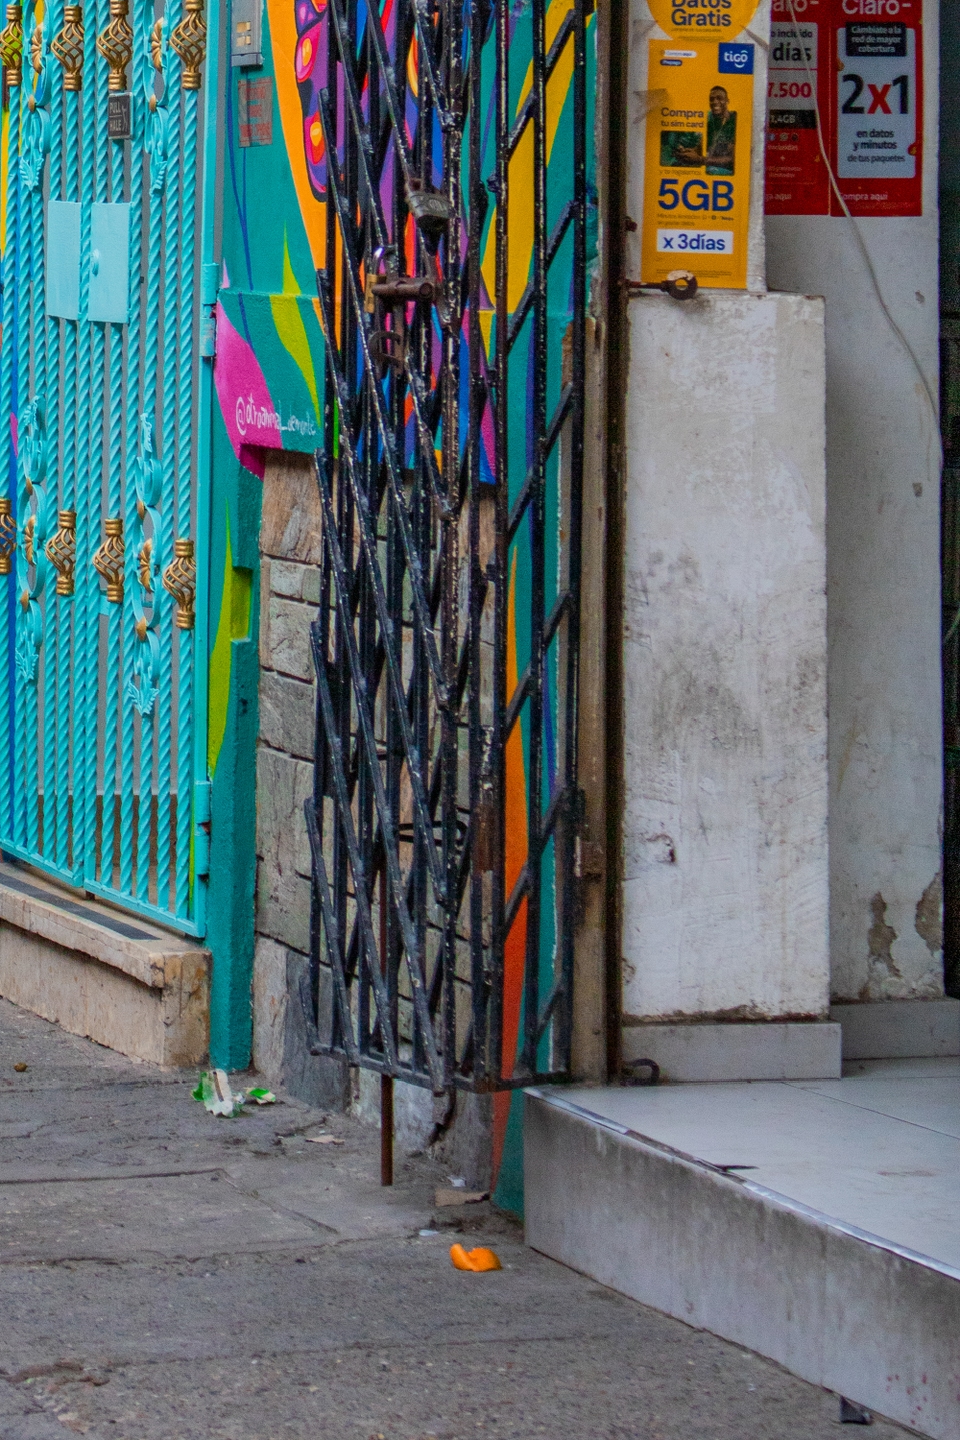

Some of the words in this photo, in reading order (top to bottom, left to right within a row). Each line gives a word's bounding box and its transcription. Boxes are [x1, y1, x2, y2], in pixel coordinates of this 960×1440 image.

[671, 9, 731, 27] Gratis
[851, 35, 865, 43] red
[866, 35, 876, 43] de
[876, 36, 902, 45] mayor
[724, 50, 748, 66] tigo
[842, 73, 908, 114] 2x1
[661, 107, 704, 120] Compra
[869, 129, 894, 138] datos
[853, 142, 859, 151] y
[861, 140, 897, 149] minutos
[847, 154, 857, 162] de
[871, 155, 906, 163] paquetes
[658, 178, 734, 211] 5GB
[663, 237, 674, 249] x
[678, 233, 725, 250] 3días
